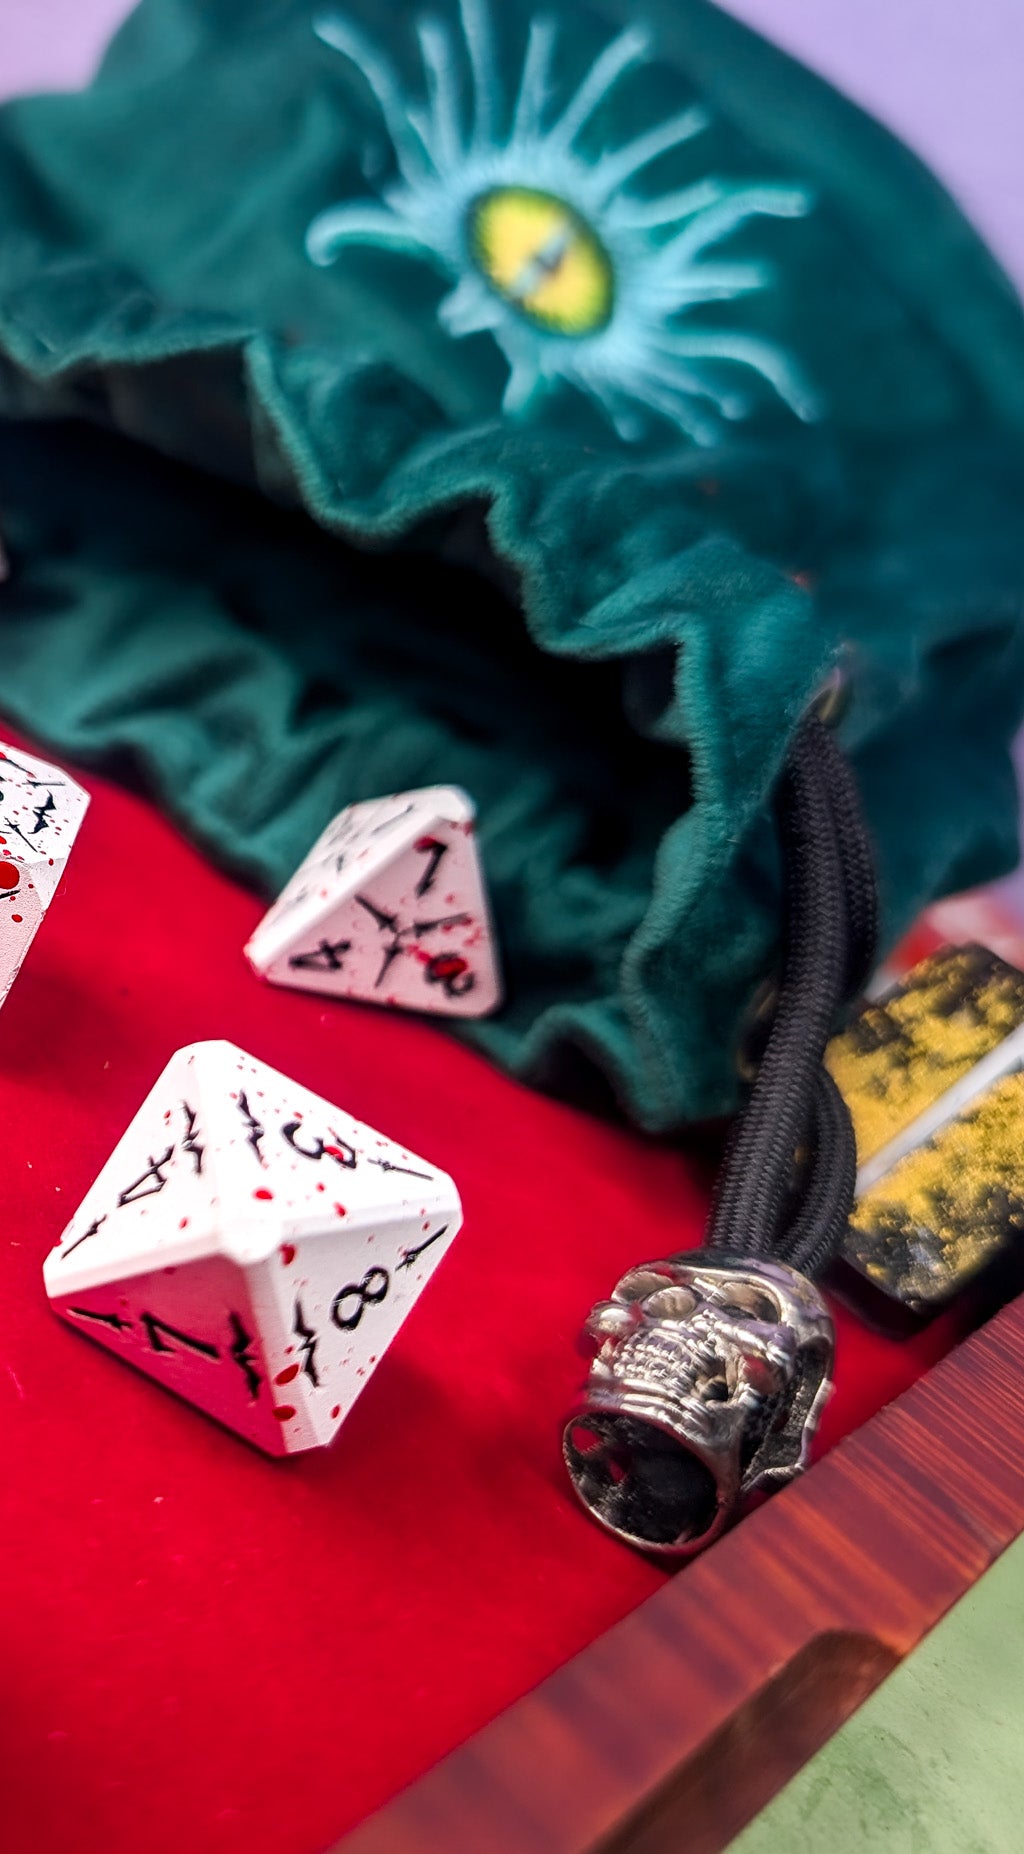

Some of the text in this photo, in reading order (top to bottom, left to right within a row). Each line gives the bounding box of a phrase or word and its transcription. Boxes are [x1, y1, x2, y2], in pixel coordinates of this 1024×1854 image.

[288, 940, 352, 972] 4
[280, 1120, 358, 1169] 3
[115, 1144, 176, 1209] 4
[330, 1265, 391, 1331] 8
